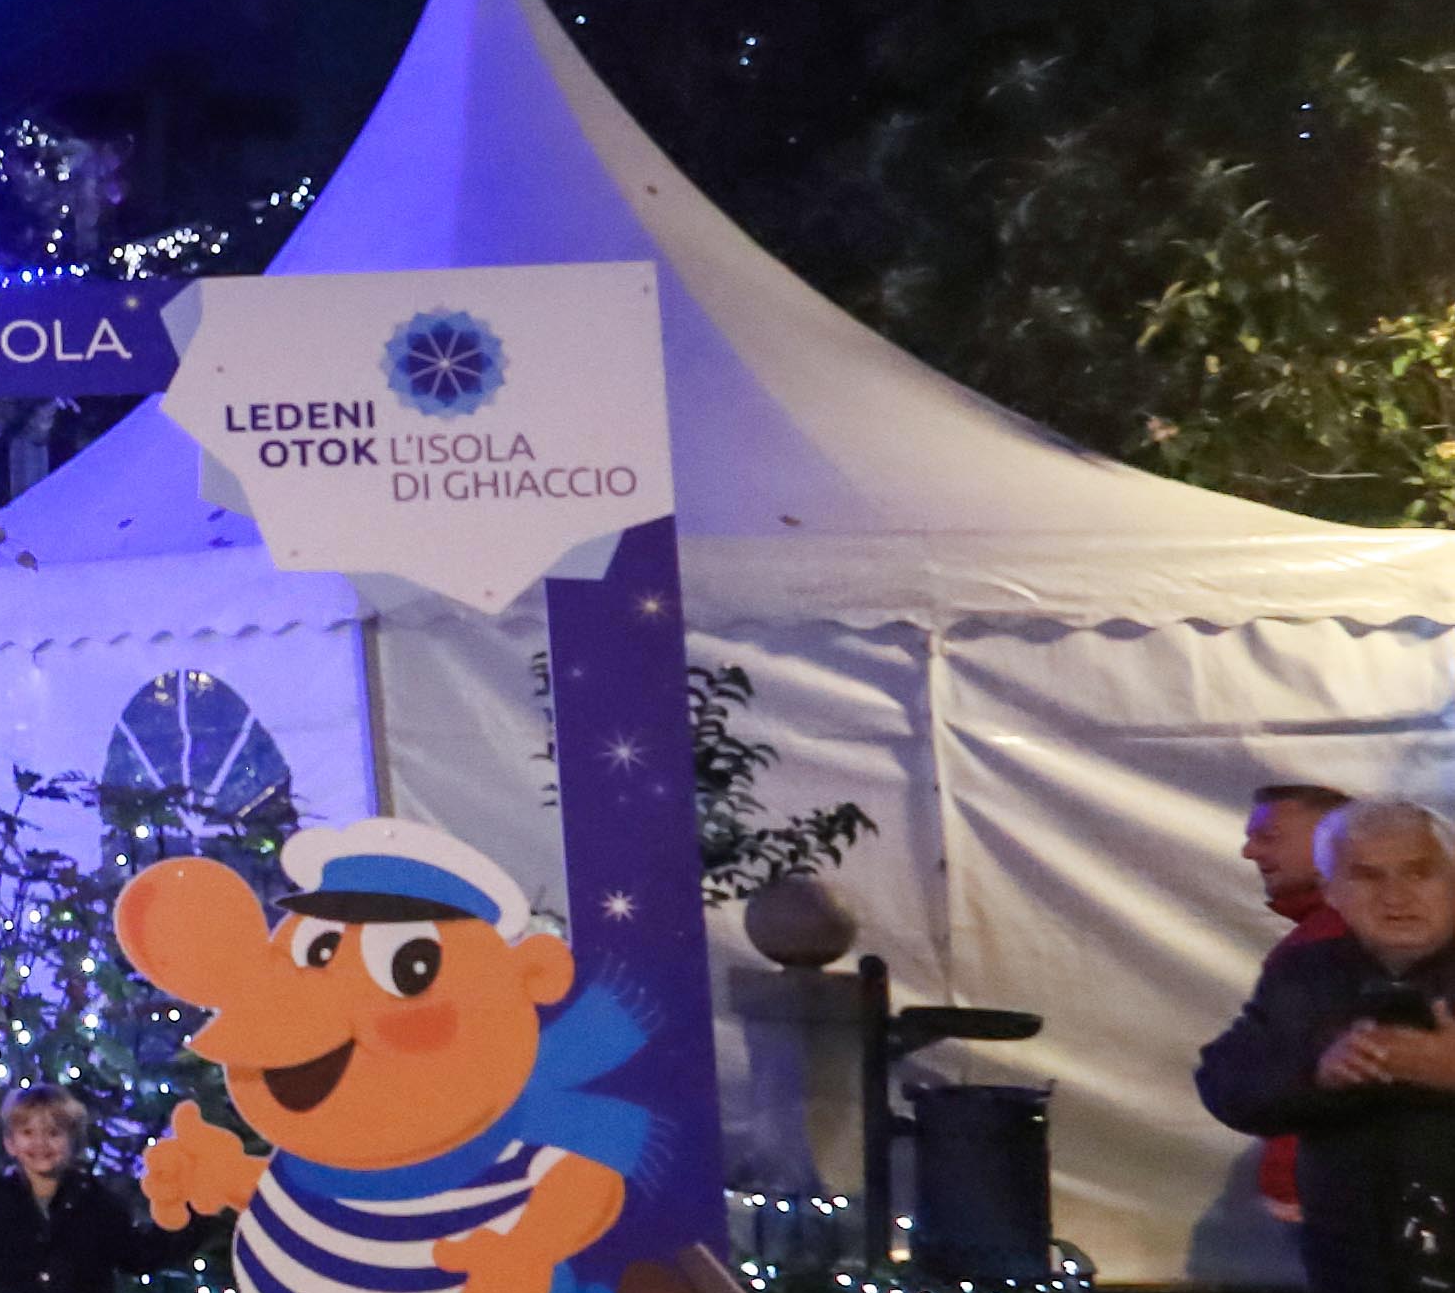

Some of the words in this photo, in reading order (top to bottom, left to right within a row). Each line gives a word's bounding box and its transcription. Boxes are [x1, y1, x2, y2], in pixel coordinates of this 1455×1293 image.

[225, 400, 376, 433] LEDENI
[258, 436, 379, 468] OTOK
[389, 432, 537, 466] L'ISOLA
[392, 471, 431, 502] DI
[443, 465, 638, 501] GHIACCIO
